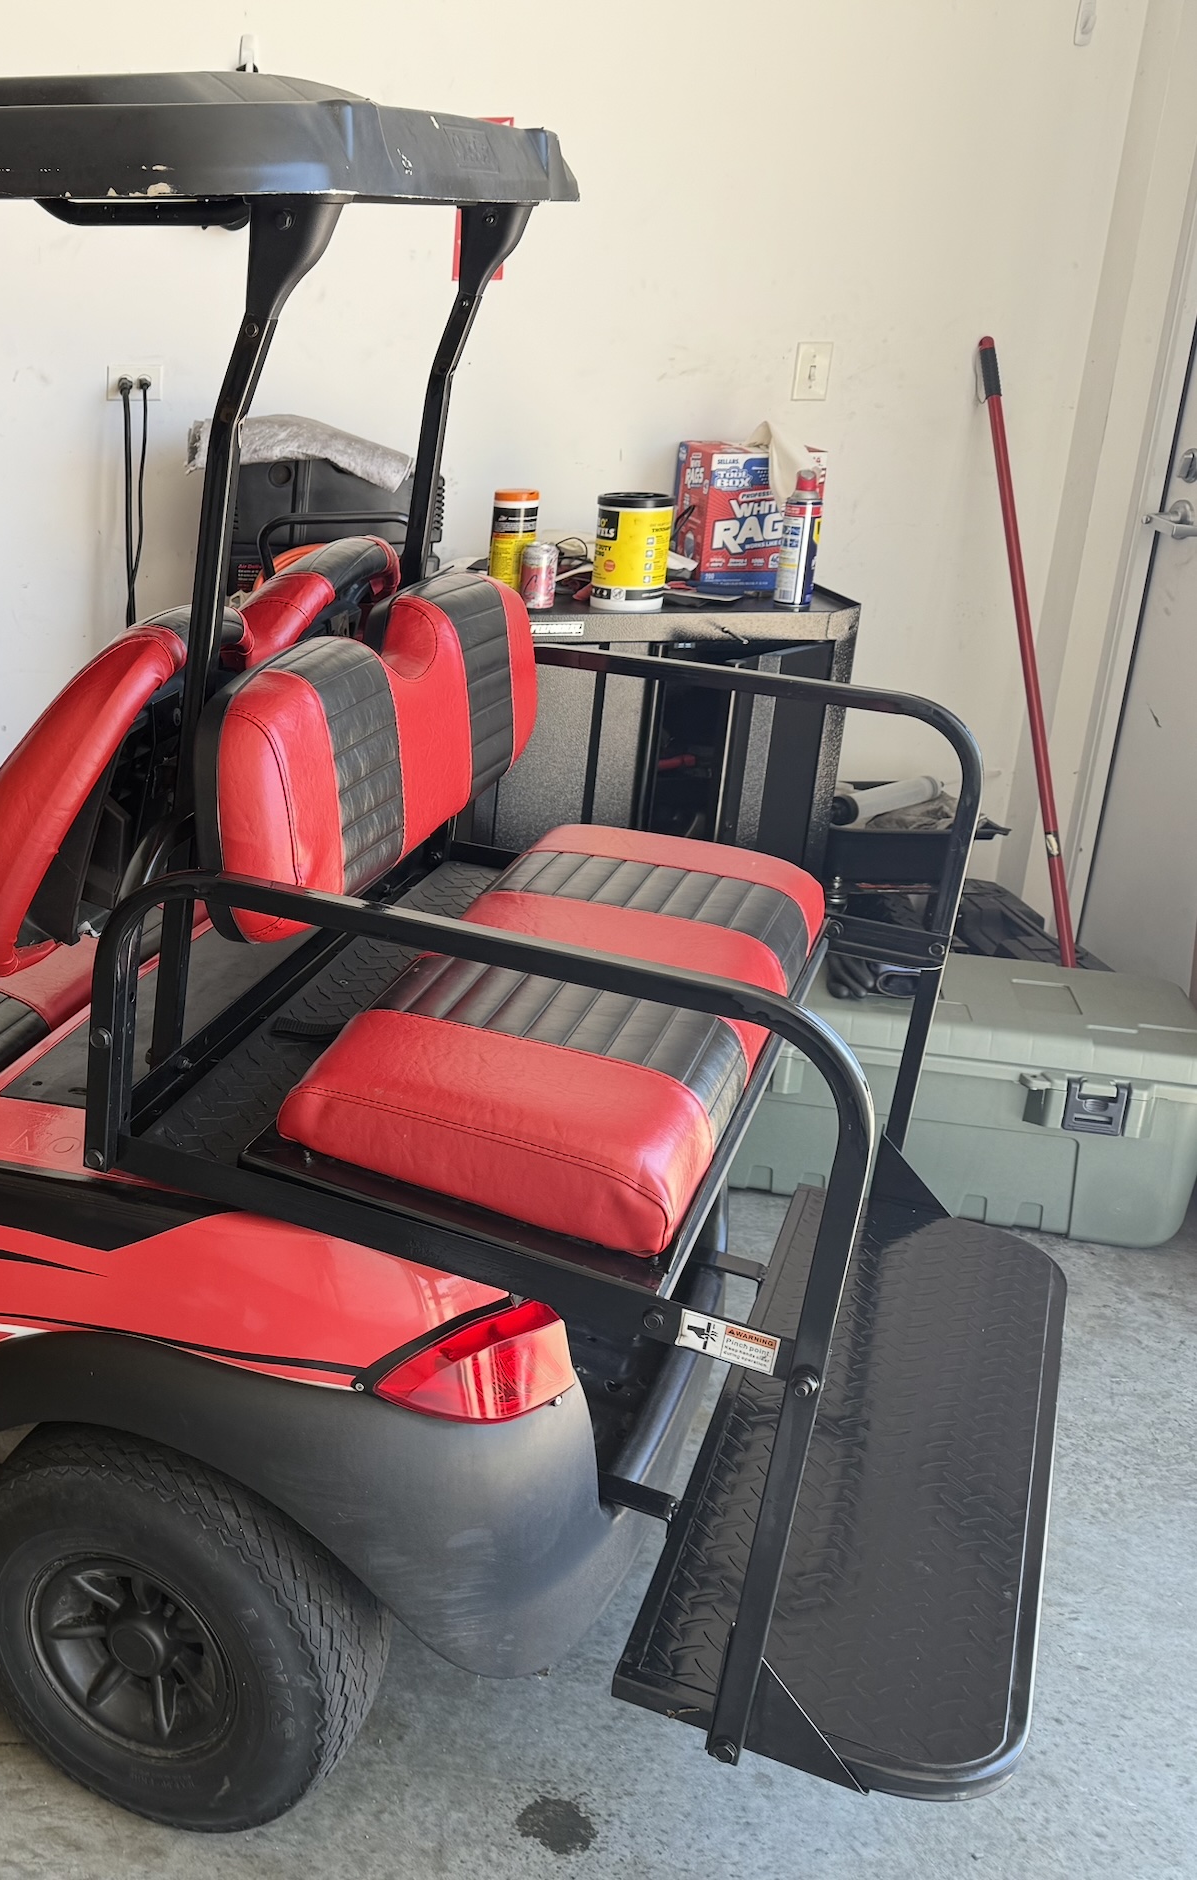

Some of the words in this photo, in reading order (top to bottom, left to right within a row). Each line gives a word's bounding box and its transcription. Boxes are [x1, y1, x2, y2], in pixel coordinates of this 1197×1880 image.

[717, 477, 751, 488] BOX
[729, 499, 776, 518] WHIT
[712, 513, 784, 554] RAG
[726, 1338, 748, 1350] Pinch
[736, 1331, 774, 1347] WARNING
[723, 1351, 740, 1360] during
[739, 1350, 755, 1358] hands
